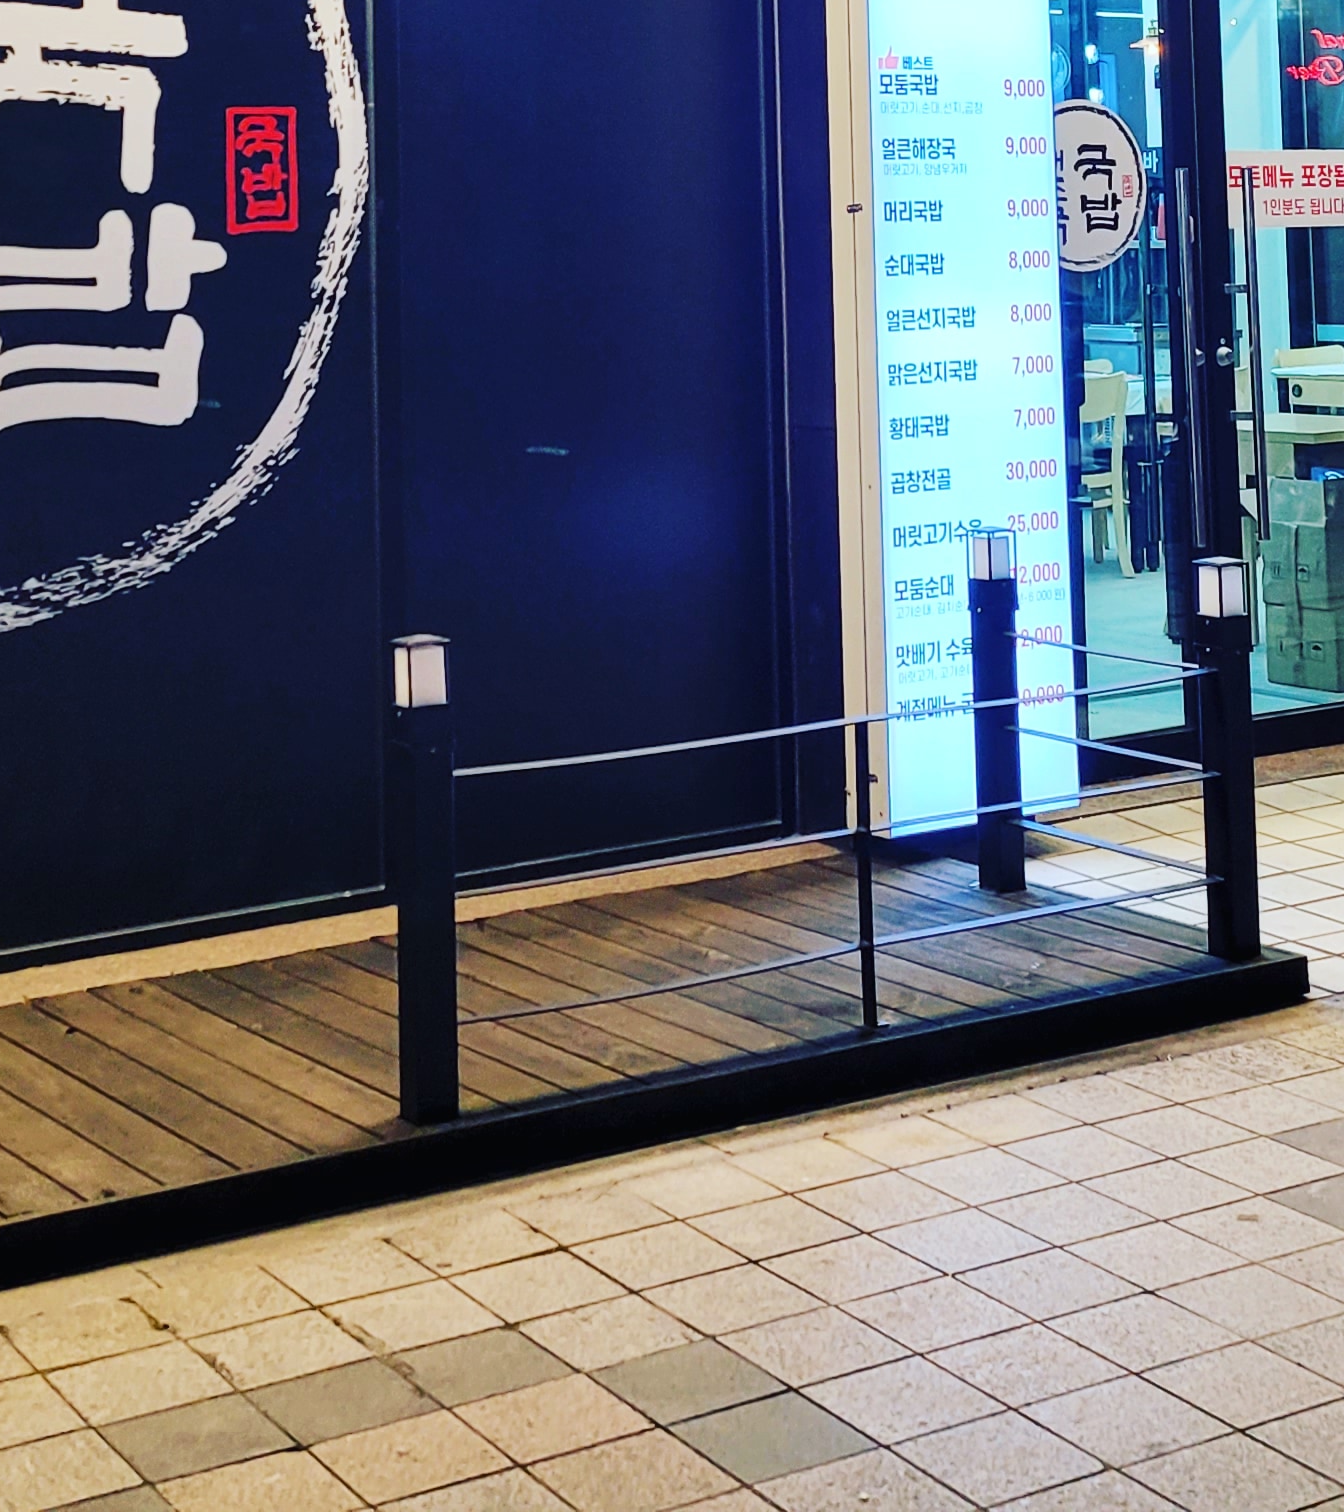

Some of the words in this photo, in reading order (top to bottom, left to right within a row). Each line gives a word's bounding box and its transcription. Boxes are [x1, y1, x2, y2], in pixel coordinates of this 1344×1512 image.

[902, 56, 934, 70] 베스트
[879, 74, 939, 96] 모둠국밥
[1004, 79, 1045, 100] 9,000
[882, 137, 956, 160] 얼큰해장국
[1005, 136, 1047, 158] 9,000
[235, 115, 288, 219] 국밥
[1073, 144, 1122, 234] 국밥
[883, 200, 943, 223] 머리국밥
[1007, 198, 1049, 219] 9,000
[1263, 199, 1306, 216] 1인분도
[884, 253, 945, 277] 순대국밥
[1008, 250, 1051, 272] 8,000
[886, 306, 976, 332] 얼큰선지국밥
[1010, 303, 1052, 325] 8,000
[887, 359, 978, 387] 맑은선지국밥
[1012, 355, 1054, 377] 7,000
[889, 414, 950, 441] 황태국밥
[1013, 406, 1055, 429] 7,000
[891, 468, 951, 495] 곱창전골
[1006, 458, 1057, 483] 30,000
[1007, 511, 1059, 535] 25,000
[894, 574, 954, 602] 모둠순대
[896, 640, 941, 668] 맛배기
[1014, 625, 1062, 650] 2,000
[1021, 684, 1064, 709] 0,000
